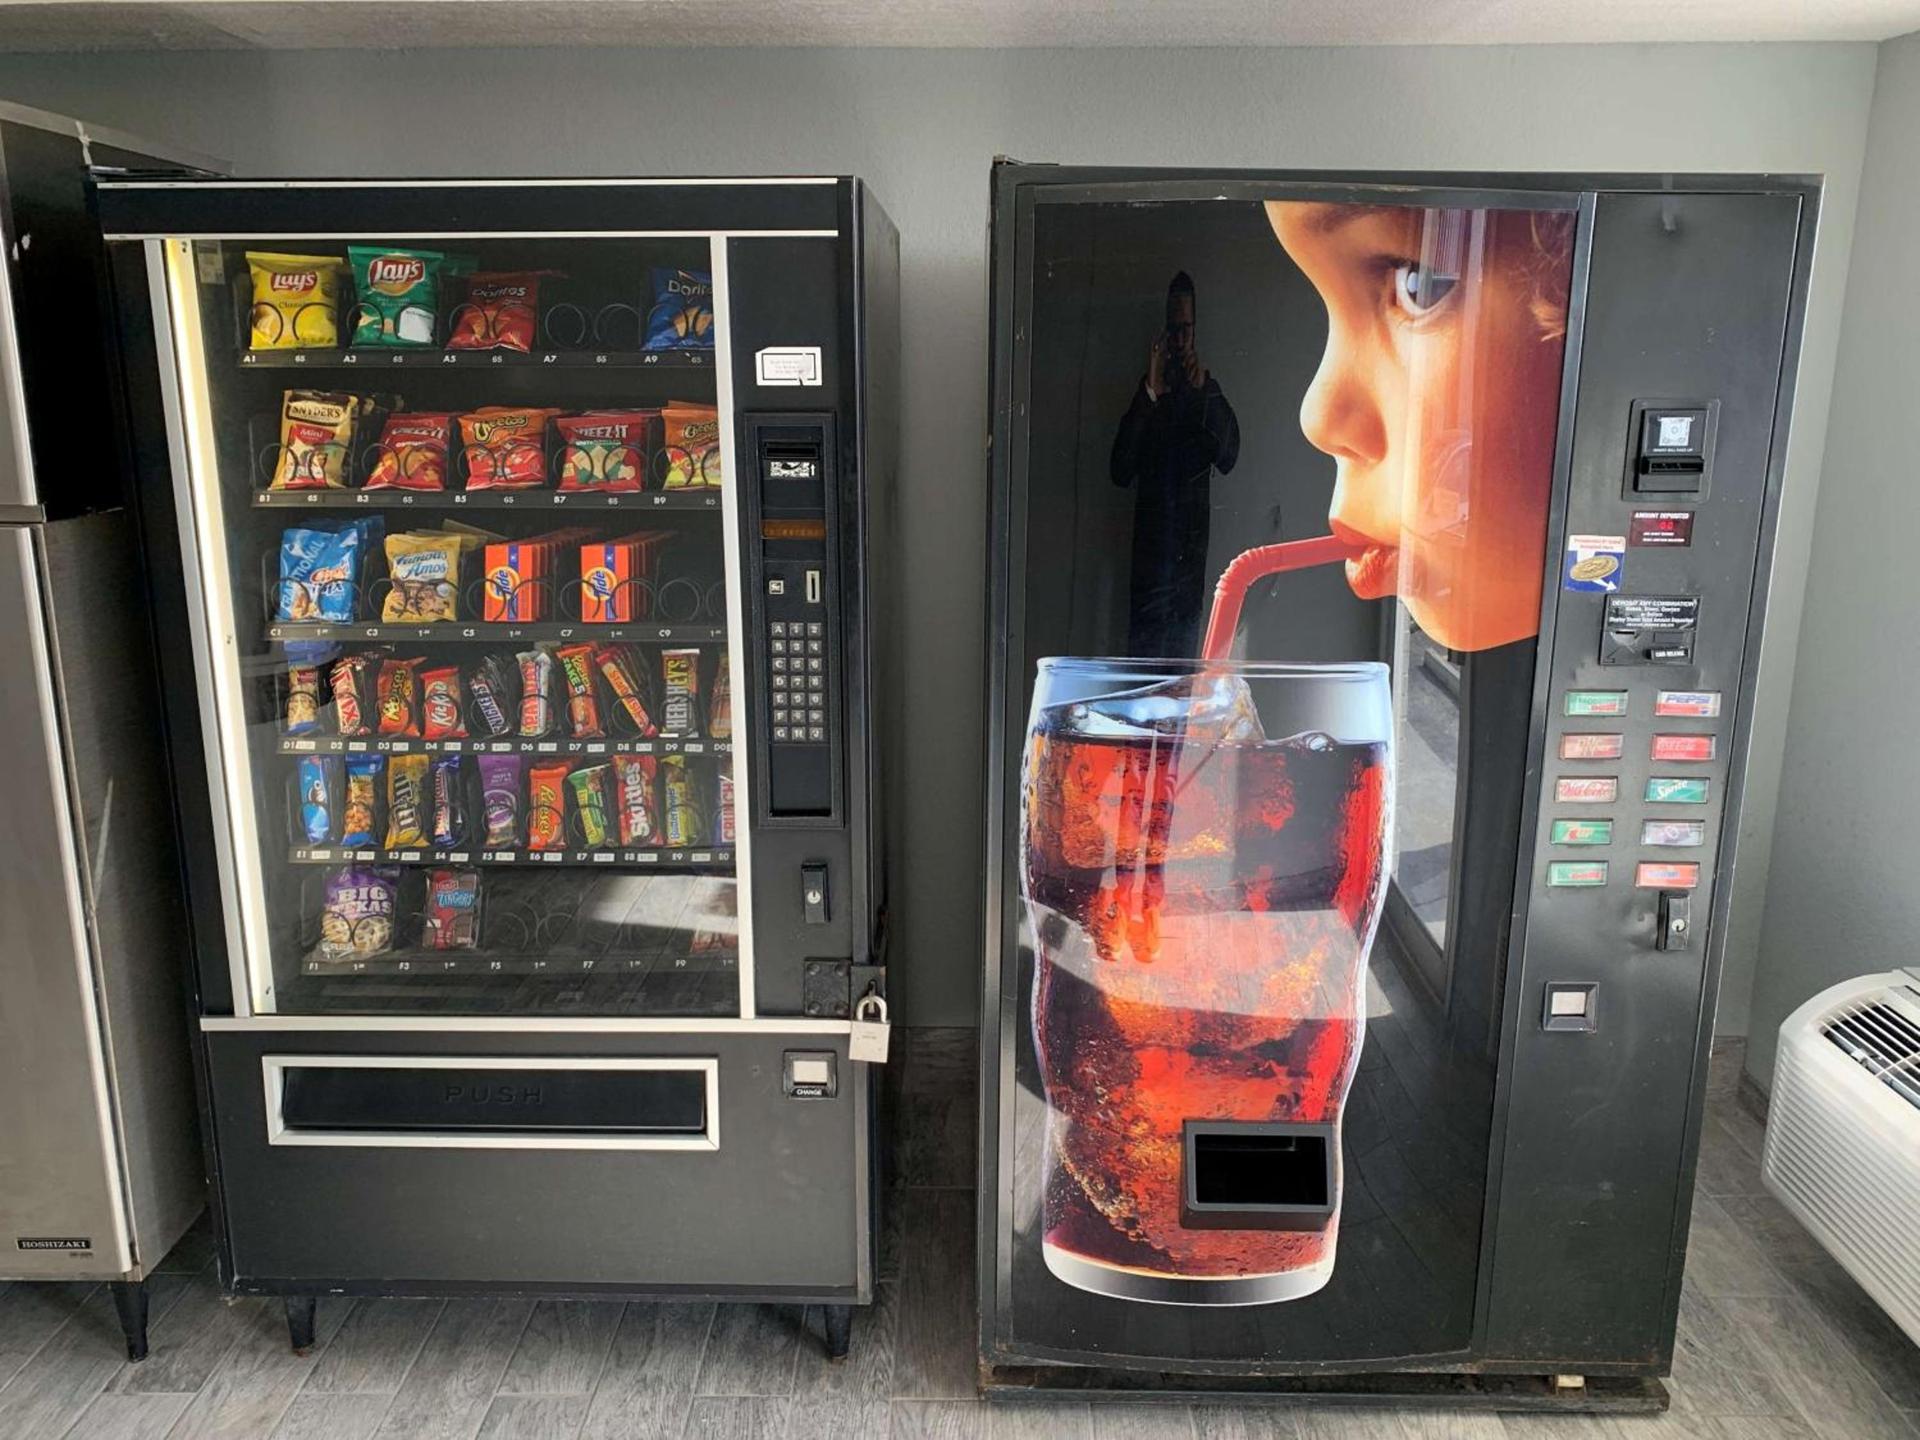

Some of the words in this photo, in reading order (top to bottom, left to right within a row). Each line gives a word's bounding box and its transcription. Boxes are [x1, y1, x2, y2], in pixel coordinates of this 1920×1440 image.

[373, 259, 422, 282] Lay's
[273, 271, 315, 291] Lay's
[443, 355, 456, 363] A5
[544, 355, 557, 363] A7
[645, 355, 658, 363] A9
[474, 415, 529, 442] Cheetos
[394, 552, 448, 567] Famous
[404, 562, 448, 578] Amos
[561, 630, 572, 638] C7
[659, 629, 671, 638] C9
[665, 658, 689, 729] HERSHEY'S
[283, 741, 295, 749] D1
[330, 742, 343, 750] D2
[378, 742, 390, 750] D3
[425, 742, 438, 750] D4
[473, 743, 486, 751] D5
[521, 743, 534, 751] D6
[569, 743, 582, 751] D7
[665, 743, 678, 751] D9
[625, 762, 650, 837] Skittles
[539, 785, 556, 835] Reese's
[338, 886, 388, 901] BIG
[334, 900, 392, 914] TEXAS
[444, 1085, 543, 1104] PUSH
[796, 1088, 822, 1096] CHANGE
[22, 1240, 87, 1249] HOSHIZAKI
